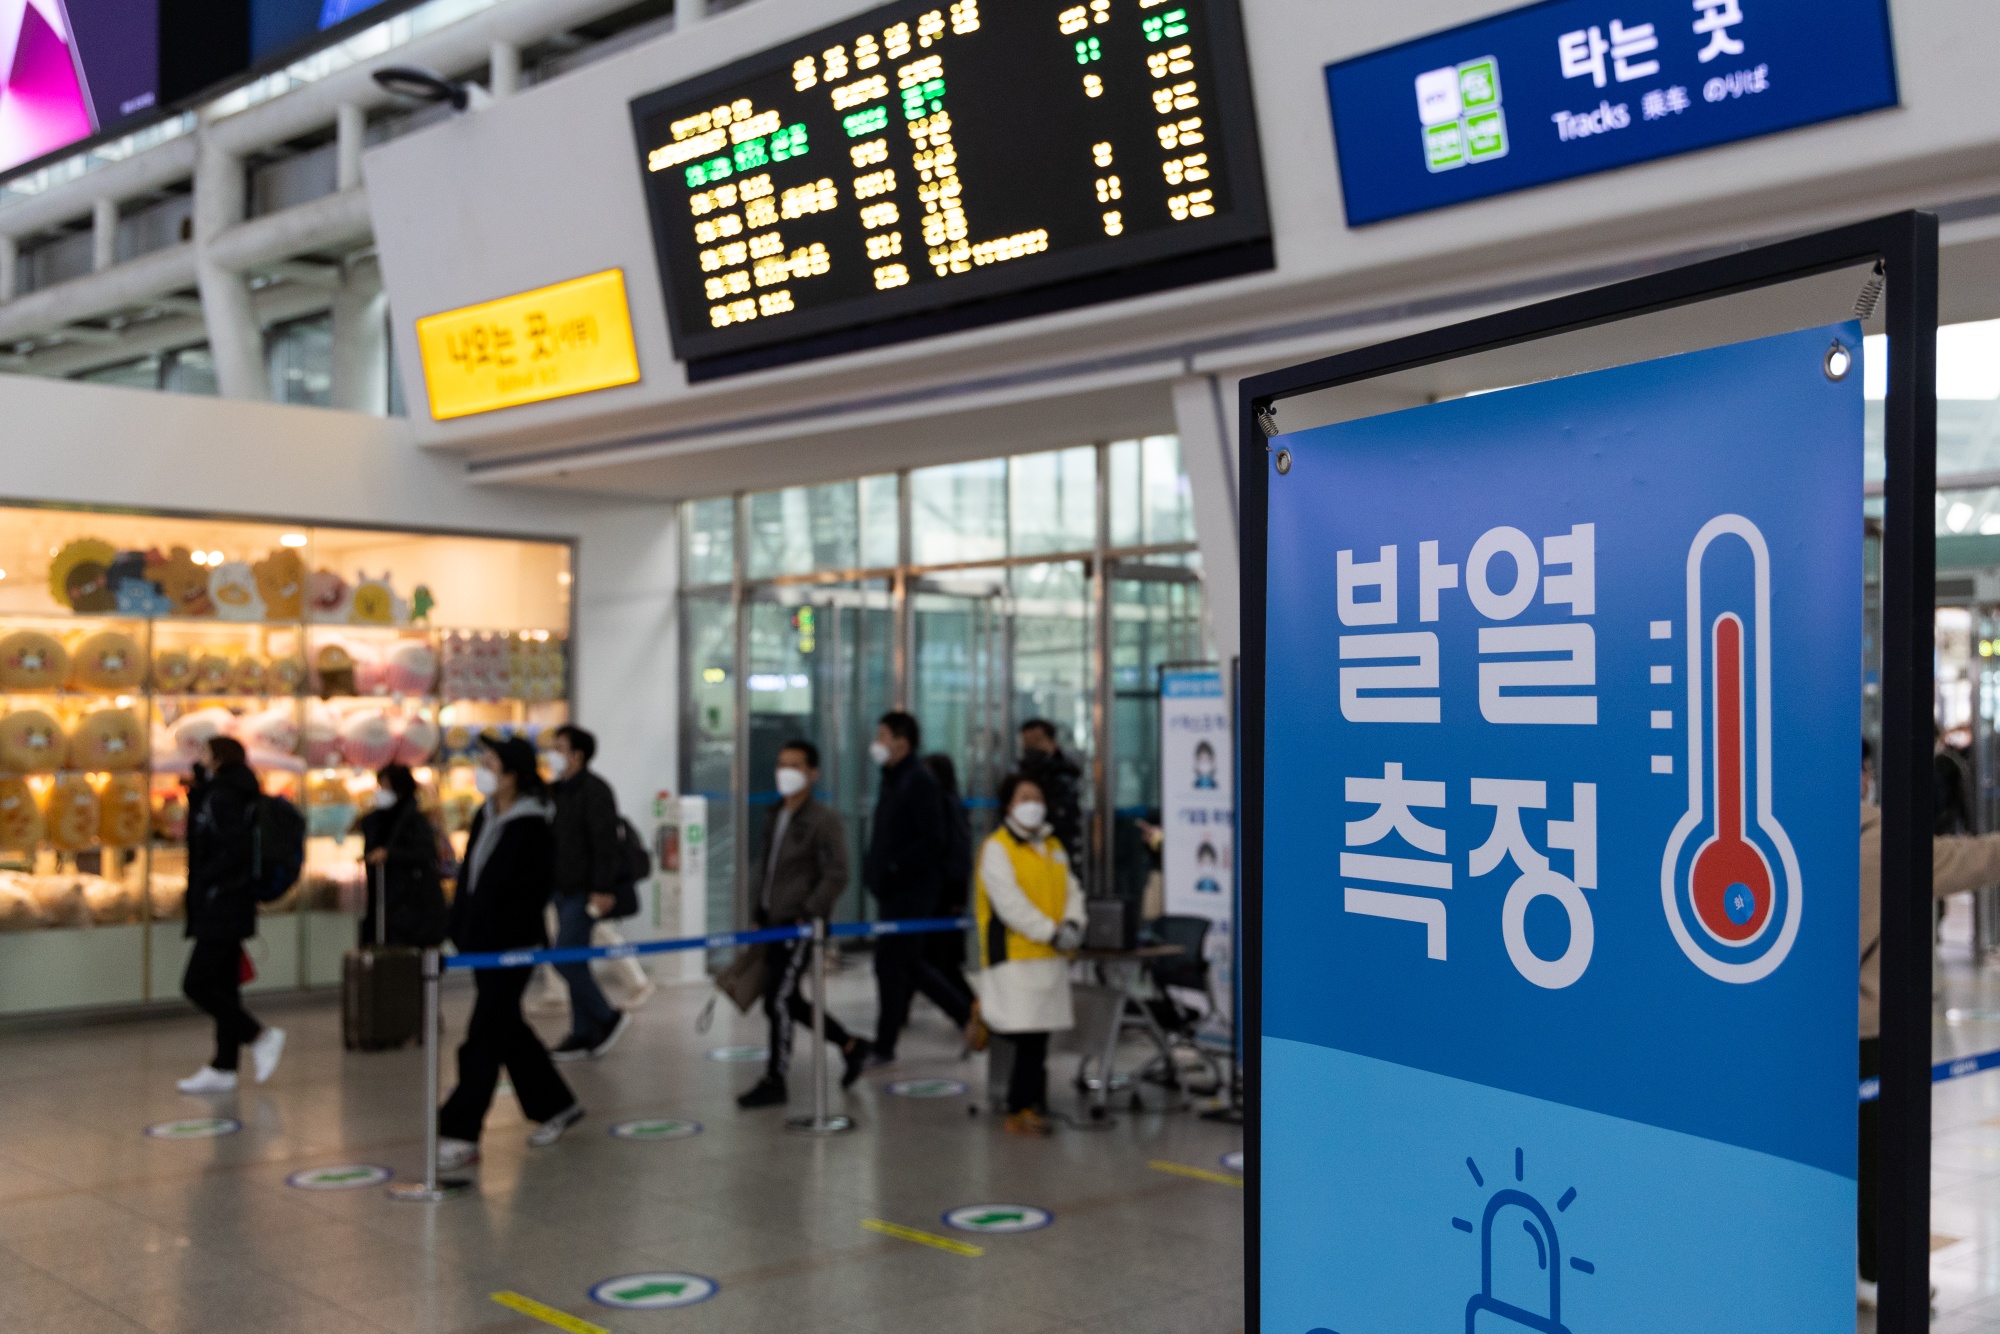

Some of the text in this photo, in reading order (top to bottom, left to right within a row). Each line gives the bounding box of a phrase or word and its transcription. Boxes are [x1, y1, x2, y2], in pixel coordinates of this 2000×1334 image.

[1557, 19, 1660, 89] 타는
[1692, 0, 1745, 64] 곳
[1551, 100, 1631, 142] Tracks
[1702, 63, 1770, 103] のりば
[445, 322, 518, 374] 나오는
[526, 312, 551, 360] 곳
[1336, 522, 1597, 724] 발열
[1339, 762, 1597, 989] 측정
